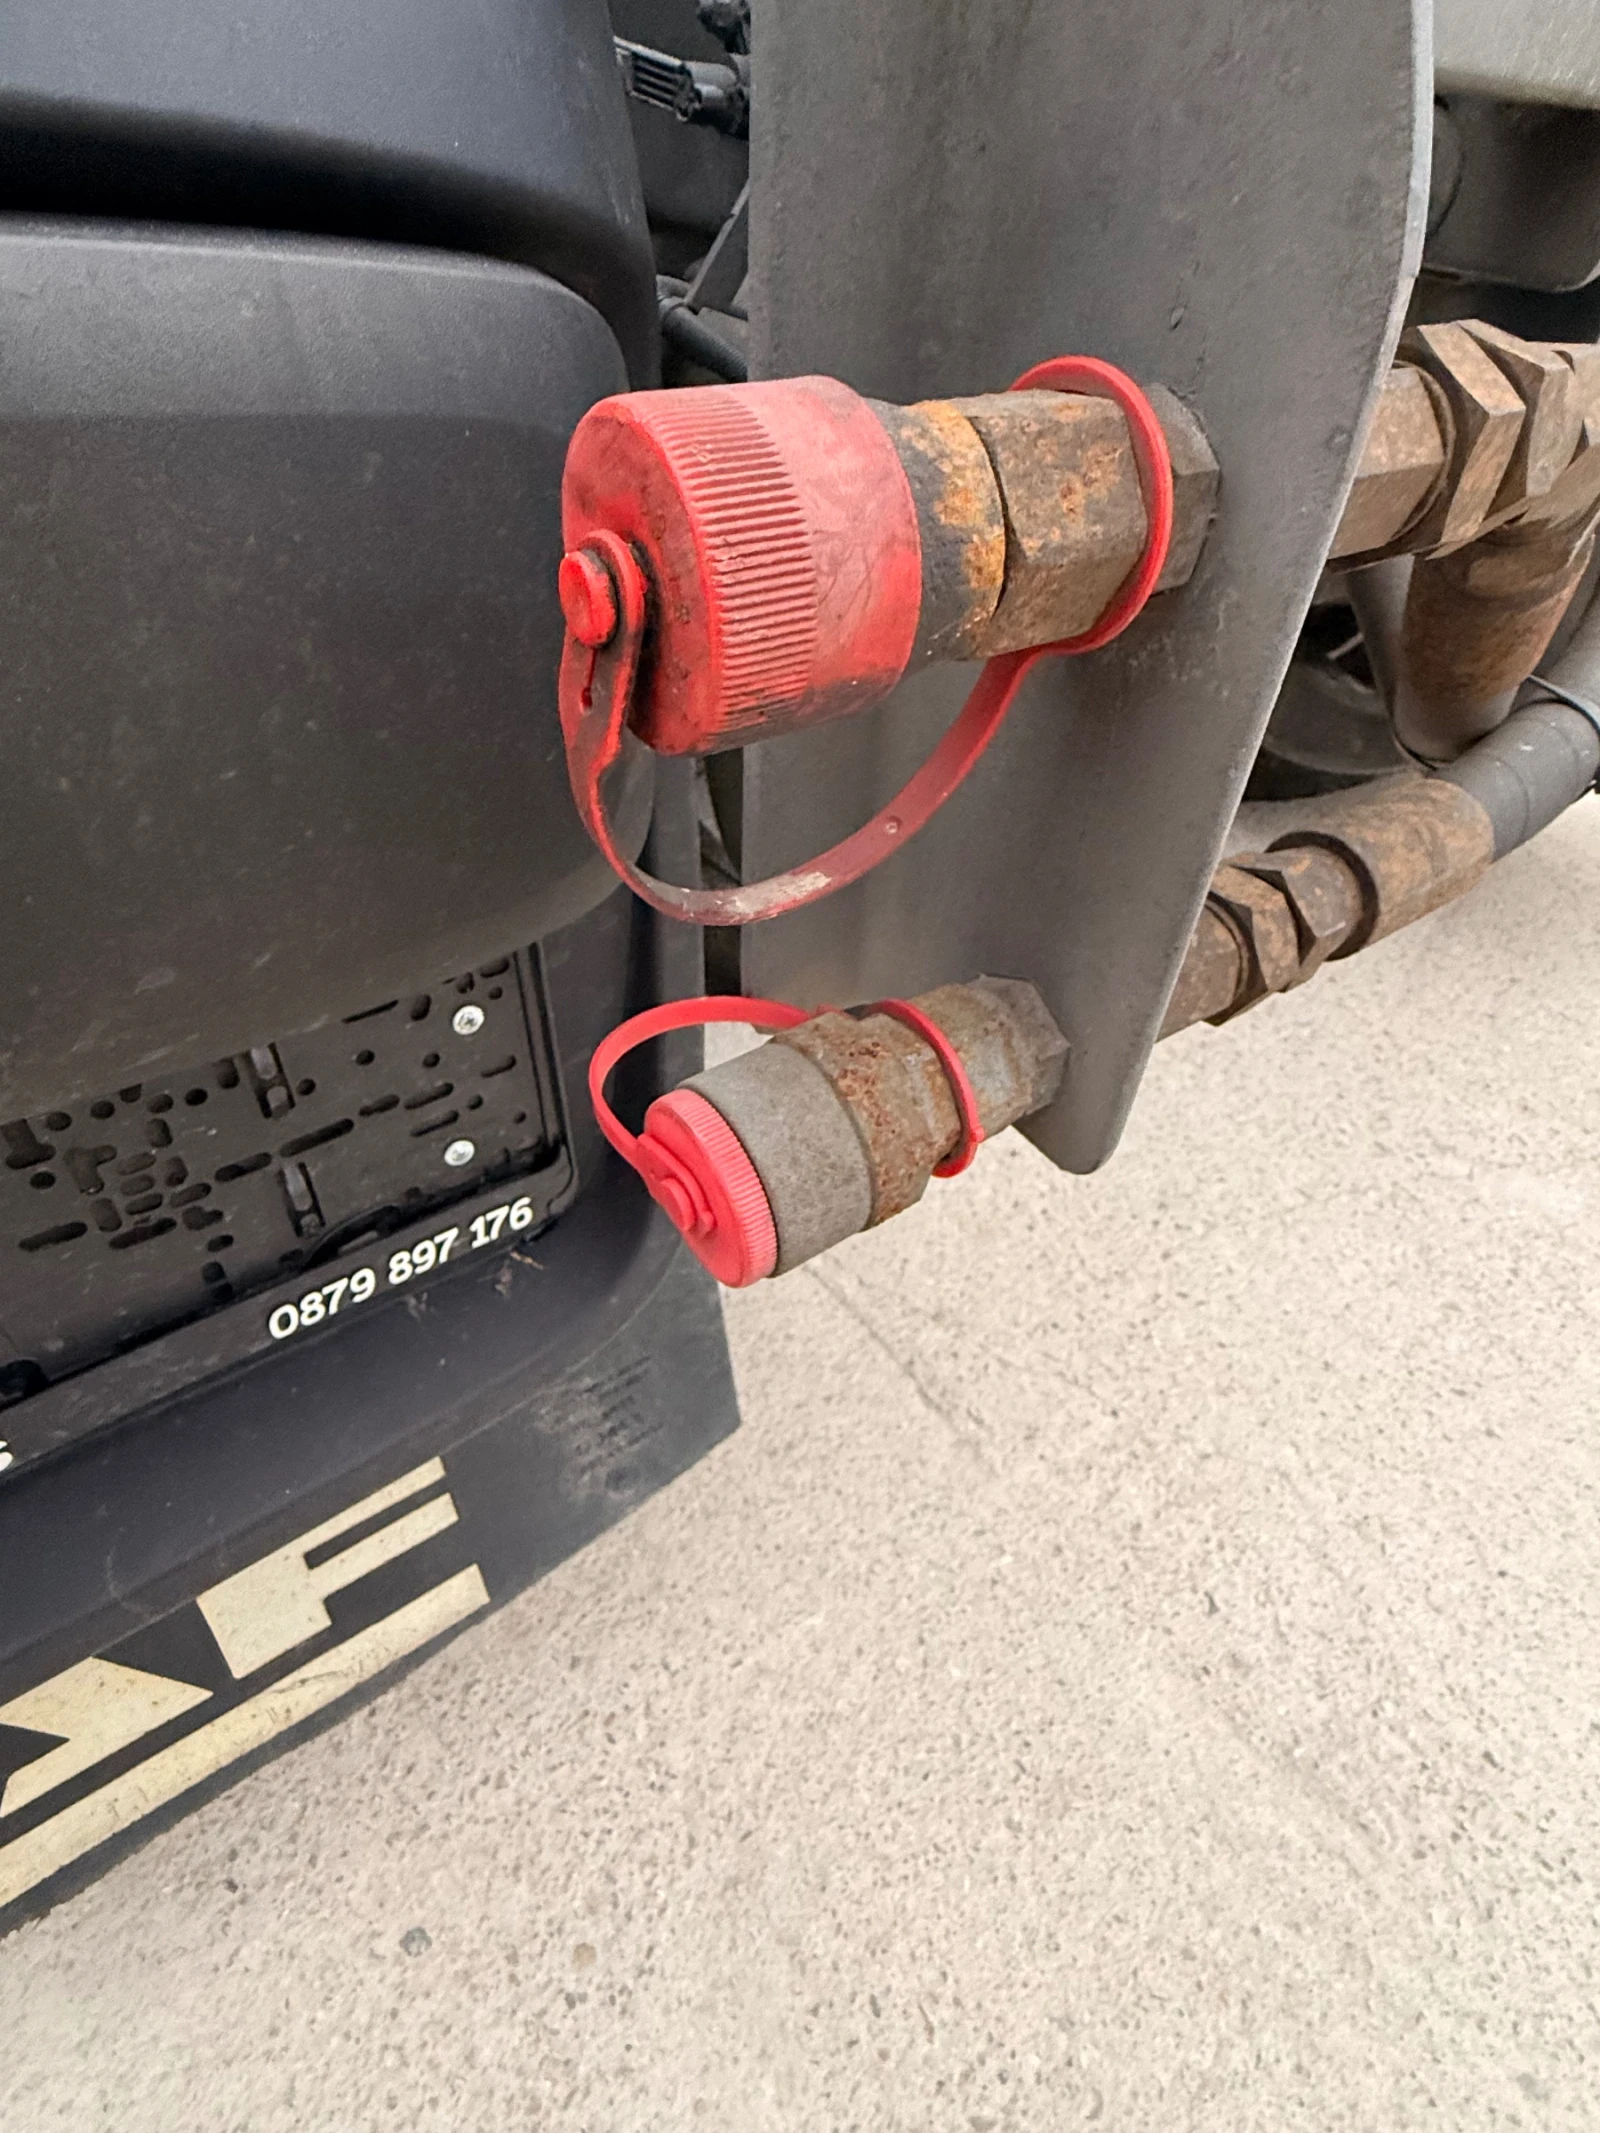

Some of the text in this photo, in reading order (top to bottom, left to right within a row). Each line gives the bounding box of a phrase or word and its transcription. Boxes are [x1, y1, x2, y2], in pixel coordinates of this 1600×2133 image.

[268, 1196, 534, 1340] 0879 897 176
[0, 1455, 460, 1819] AF
